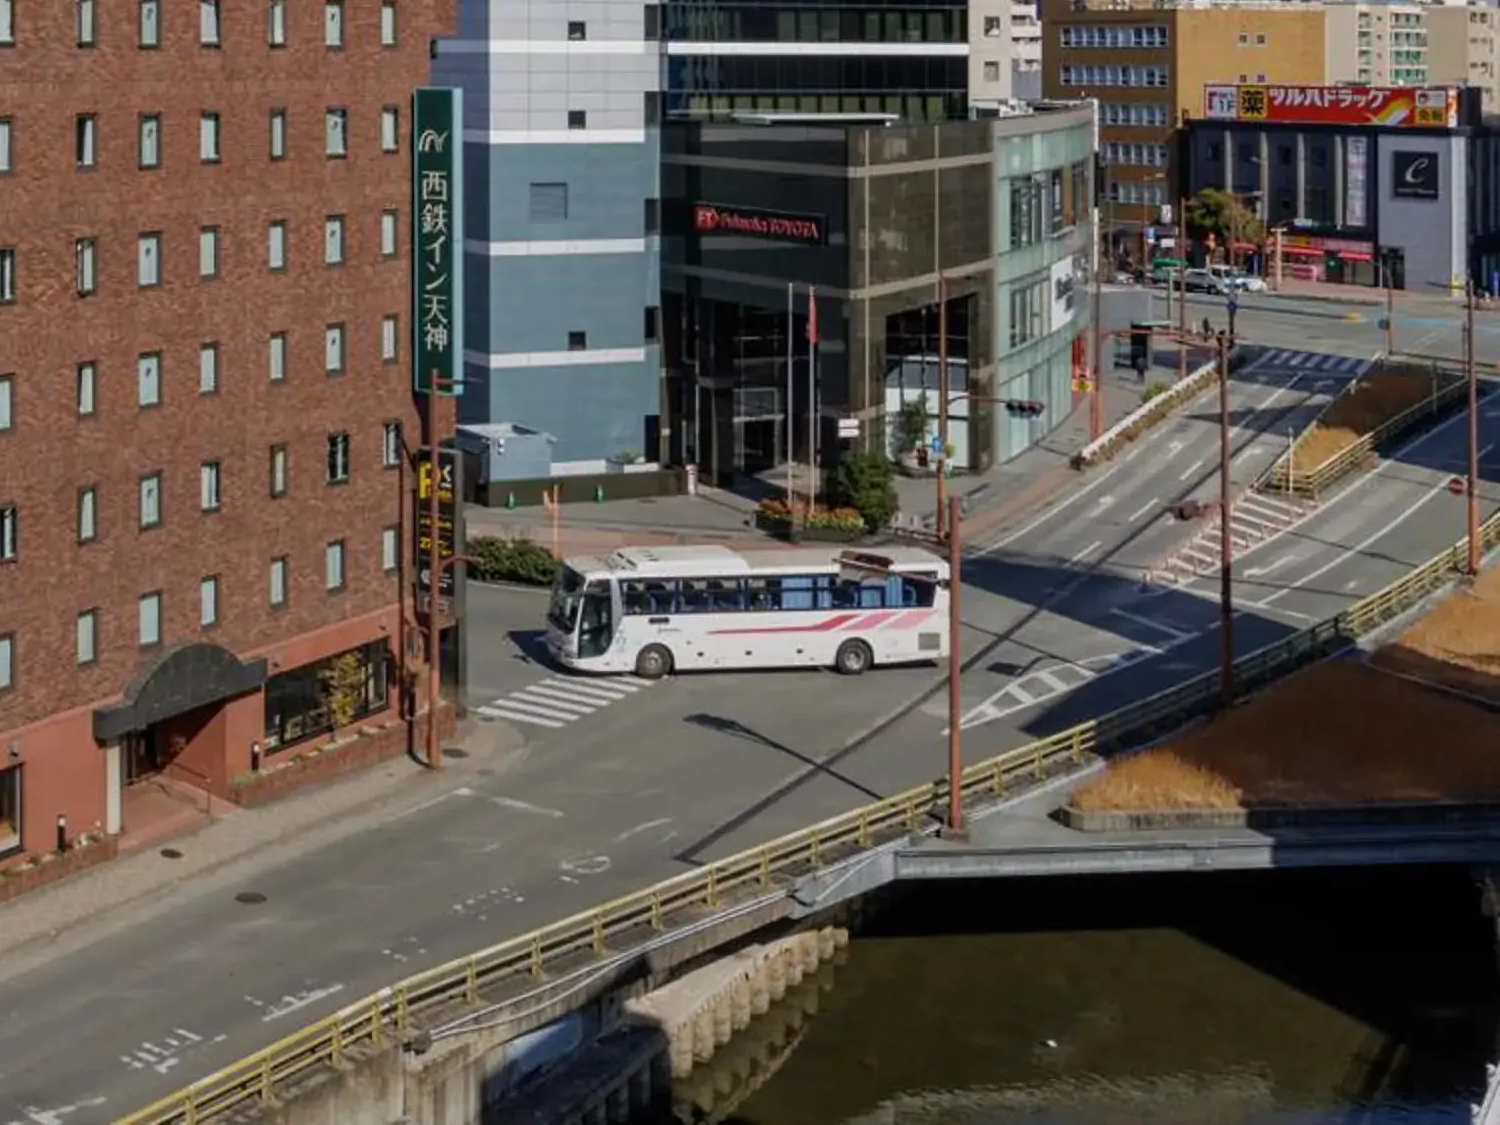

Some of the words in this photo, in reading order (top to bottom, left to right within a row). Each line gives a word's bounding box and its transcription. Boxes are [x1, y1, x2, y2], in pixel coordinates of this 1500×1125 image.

[1268, 88, 1392, 108] ツルハドラッグ
[421, 170, 448, 352] 西鉄イン天神
